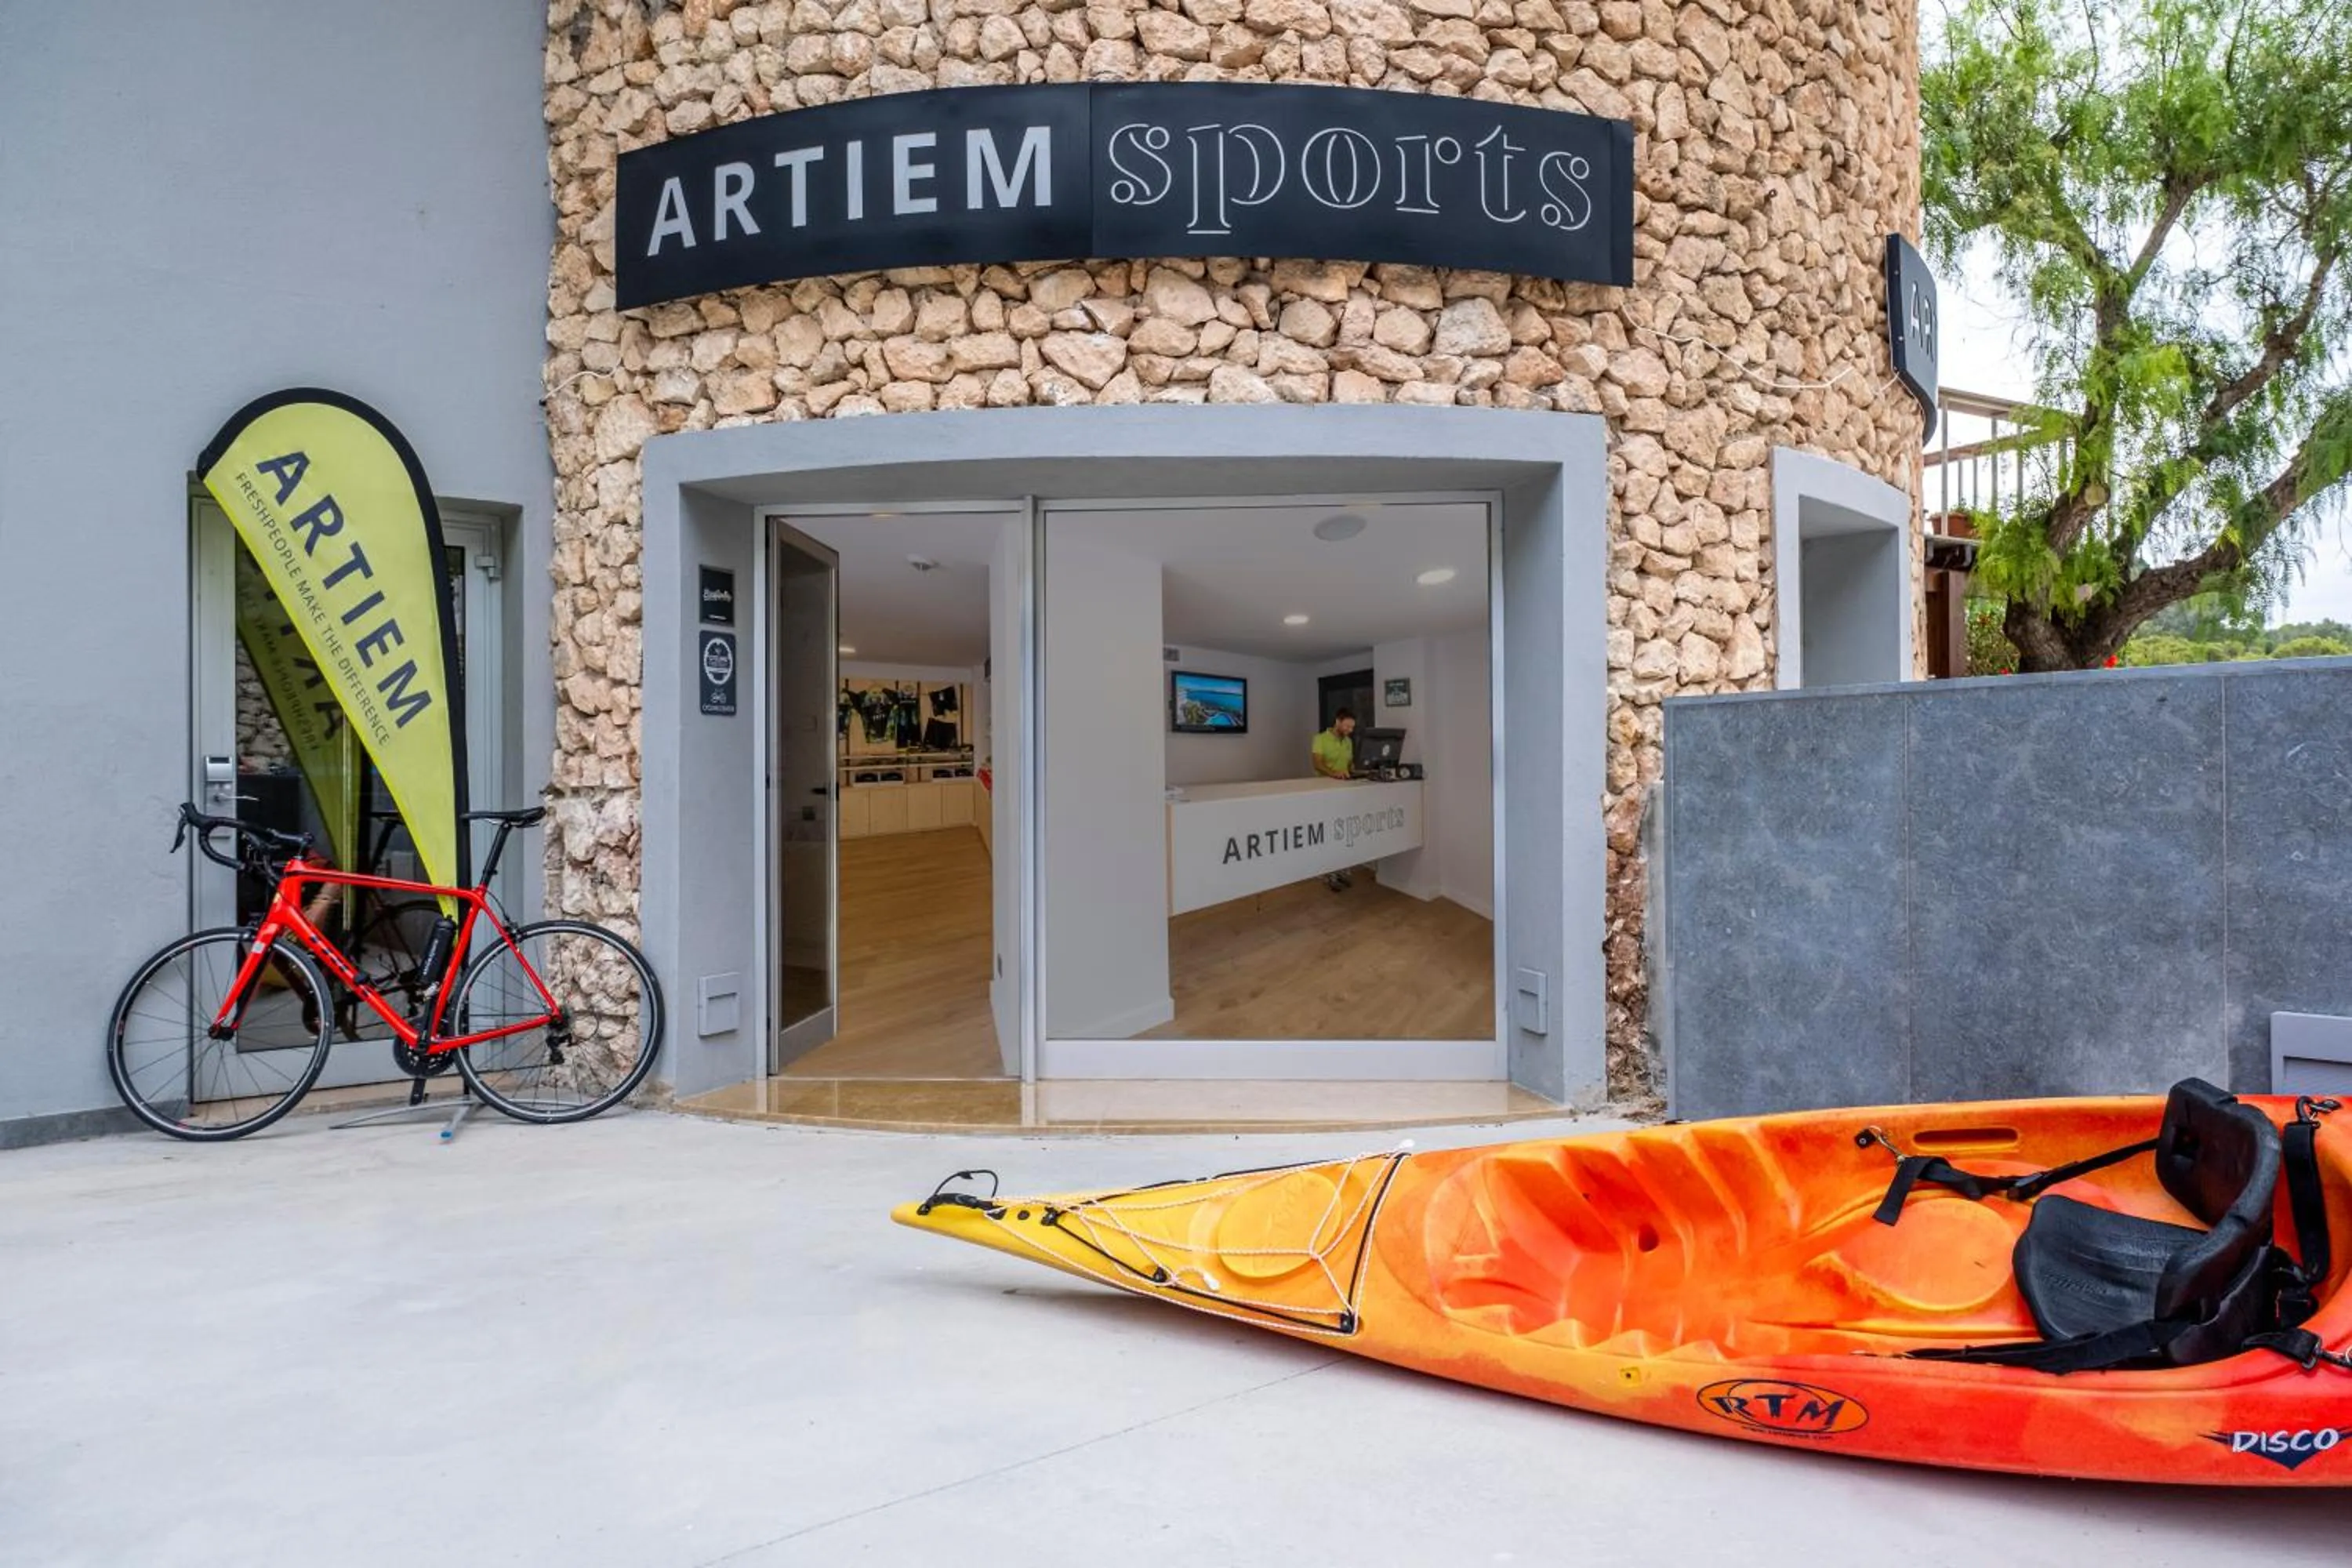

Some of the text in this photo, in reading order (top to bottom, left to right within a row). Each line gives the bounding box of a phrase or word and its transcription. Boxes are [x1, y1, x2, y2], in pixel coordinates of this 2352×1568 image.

[647, 124, 1592, 257] ARTIEM sports
[235, 472, 303, 579] FRESHPEOPLE
[296, 579, 328, 625] MAKE
[321, 624, 345, 656] THE
[337, 657, 391, 746] DIFFERENCE
[256, 451, 433, 729] ARTIEM
[1222, 806, 1405, 865] ARTIEM sports
[1709, 1394, 1846, 1431] RTM
[2231, 1427, 2340, 1454] DISCO
